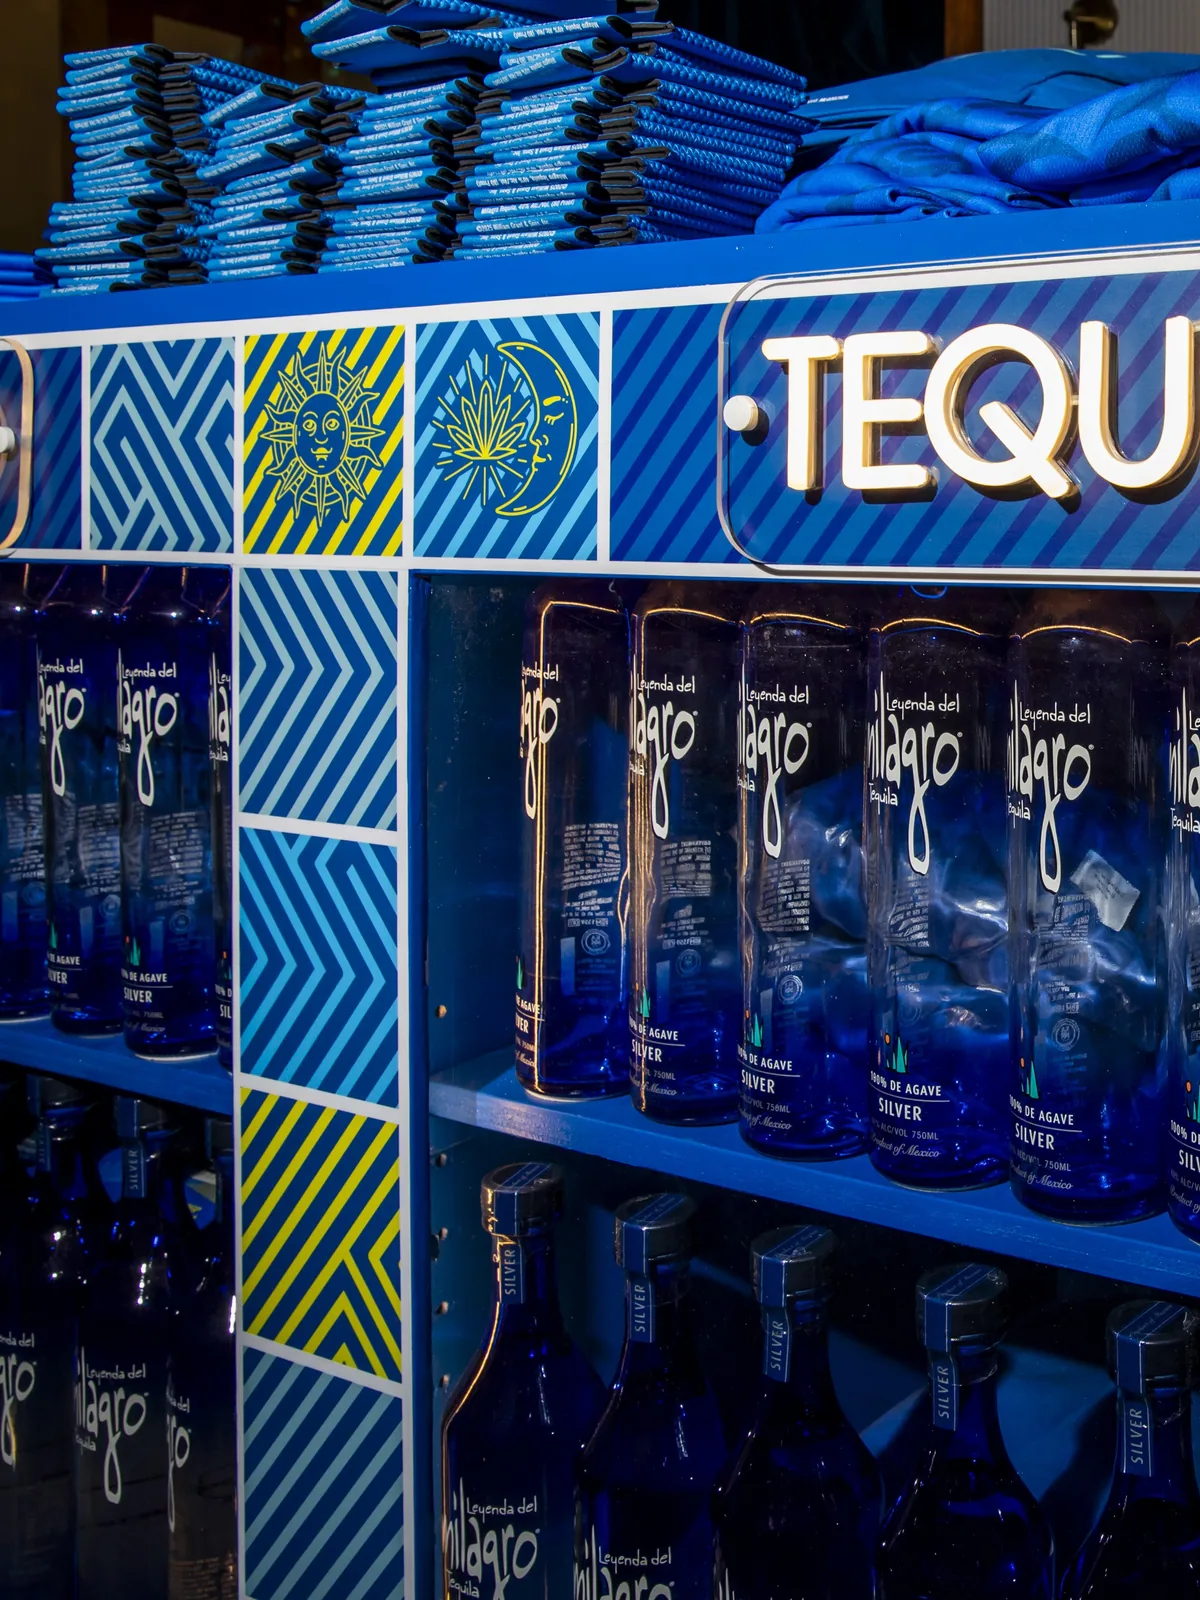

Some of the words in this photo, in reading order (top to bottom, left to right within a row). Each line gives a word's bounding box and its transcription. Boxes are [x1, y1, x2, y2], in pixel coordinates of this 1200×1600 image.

[67, 659, 83, 674] del
[122, 662, 156, 685] Leyenda
[158, 662, 176, 678] del
[543, 663, 559, 681] del
[637, 673, 674, 699] Leyenda
[676, 675, 695, 693] del
[746, 684, 786, 710] Leyenda
[788, 685, 809, 705] del
[886, 691, 935, 720] Leyenda
[938, 693, 960, 712] del
[1020, 701, 1065, 731] Leyenda
[1069, 702, 1091, 724] del
[868, 783, 898, 815] Tequila
[1170, 807, 1200, 843] Tequila
[140, 973, 167, 983] AGAVE
[124, 987, 152, 1003] SILVER
[638, 1023, 646, 1035] DE
[649, 1027, 679, 1041] AGAVE
[631, 1038, 662, 1063] SILVER
[749, 1053, 758, 1066] DE
[760, 1057, 793, 1071] AGAVE
[653, 1069, 676, 1081] 750ML
[741, 1069, 775, 1094] SILVER
[870, 1070, 887, 1088] 100%
[890, 1080, 901, 1093] DE
[905, 1083, 941, 1096] AGAVE
[649, 1083, 677, 1096] Mexico
[766, 1102, 791, 1114] 750ML
[878, 1097, 922, 1121] SILVER
[1024, 1105, 1035, 1119] DE
[1038, 1110, 1074, 1126] AGAVE
[760, 1116, 792, 1129] Mexico
[881, 1122, 908, 1138] ALC/VOL
[911, 1130, 939, 1141] 750ML
[1170, 1119, 1188, 1140] 100%
[1015, 1122, 1055, 1150] SILVER
[893, 1143, 905, 1156] of
[903, 1145, 941, 1158] Mexico
[128, 1149, 139, 1190] SILVER
[1044, 1159, 1071, 1172] 750ML
[1036, 1174, 1073, 1190] Mexico
[1170, 1184, 1193, 1208] Product
[504, 1248, 516, 1295] SILVER
[634, 1283, 646, 1333] SILVER
[770, 1319, 784, 1371] SILVER
[86, 1363, 125, 1385] Leyenda
[127, 1363, 146, 1378] del
[937, 1365, 949, 1419] SILVER
[1131, 1406, 1143, 1465] SILVER
[466, 1496, 515, 1524] Leyenda
[517, 1495, 537, 1514] del
[598, 1546, 648, 1575] Leyenda
[651, 1546, 672, 1565] del
